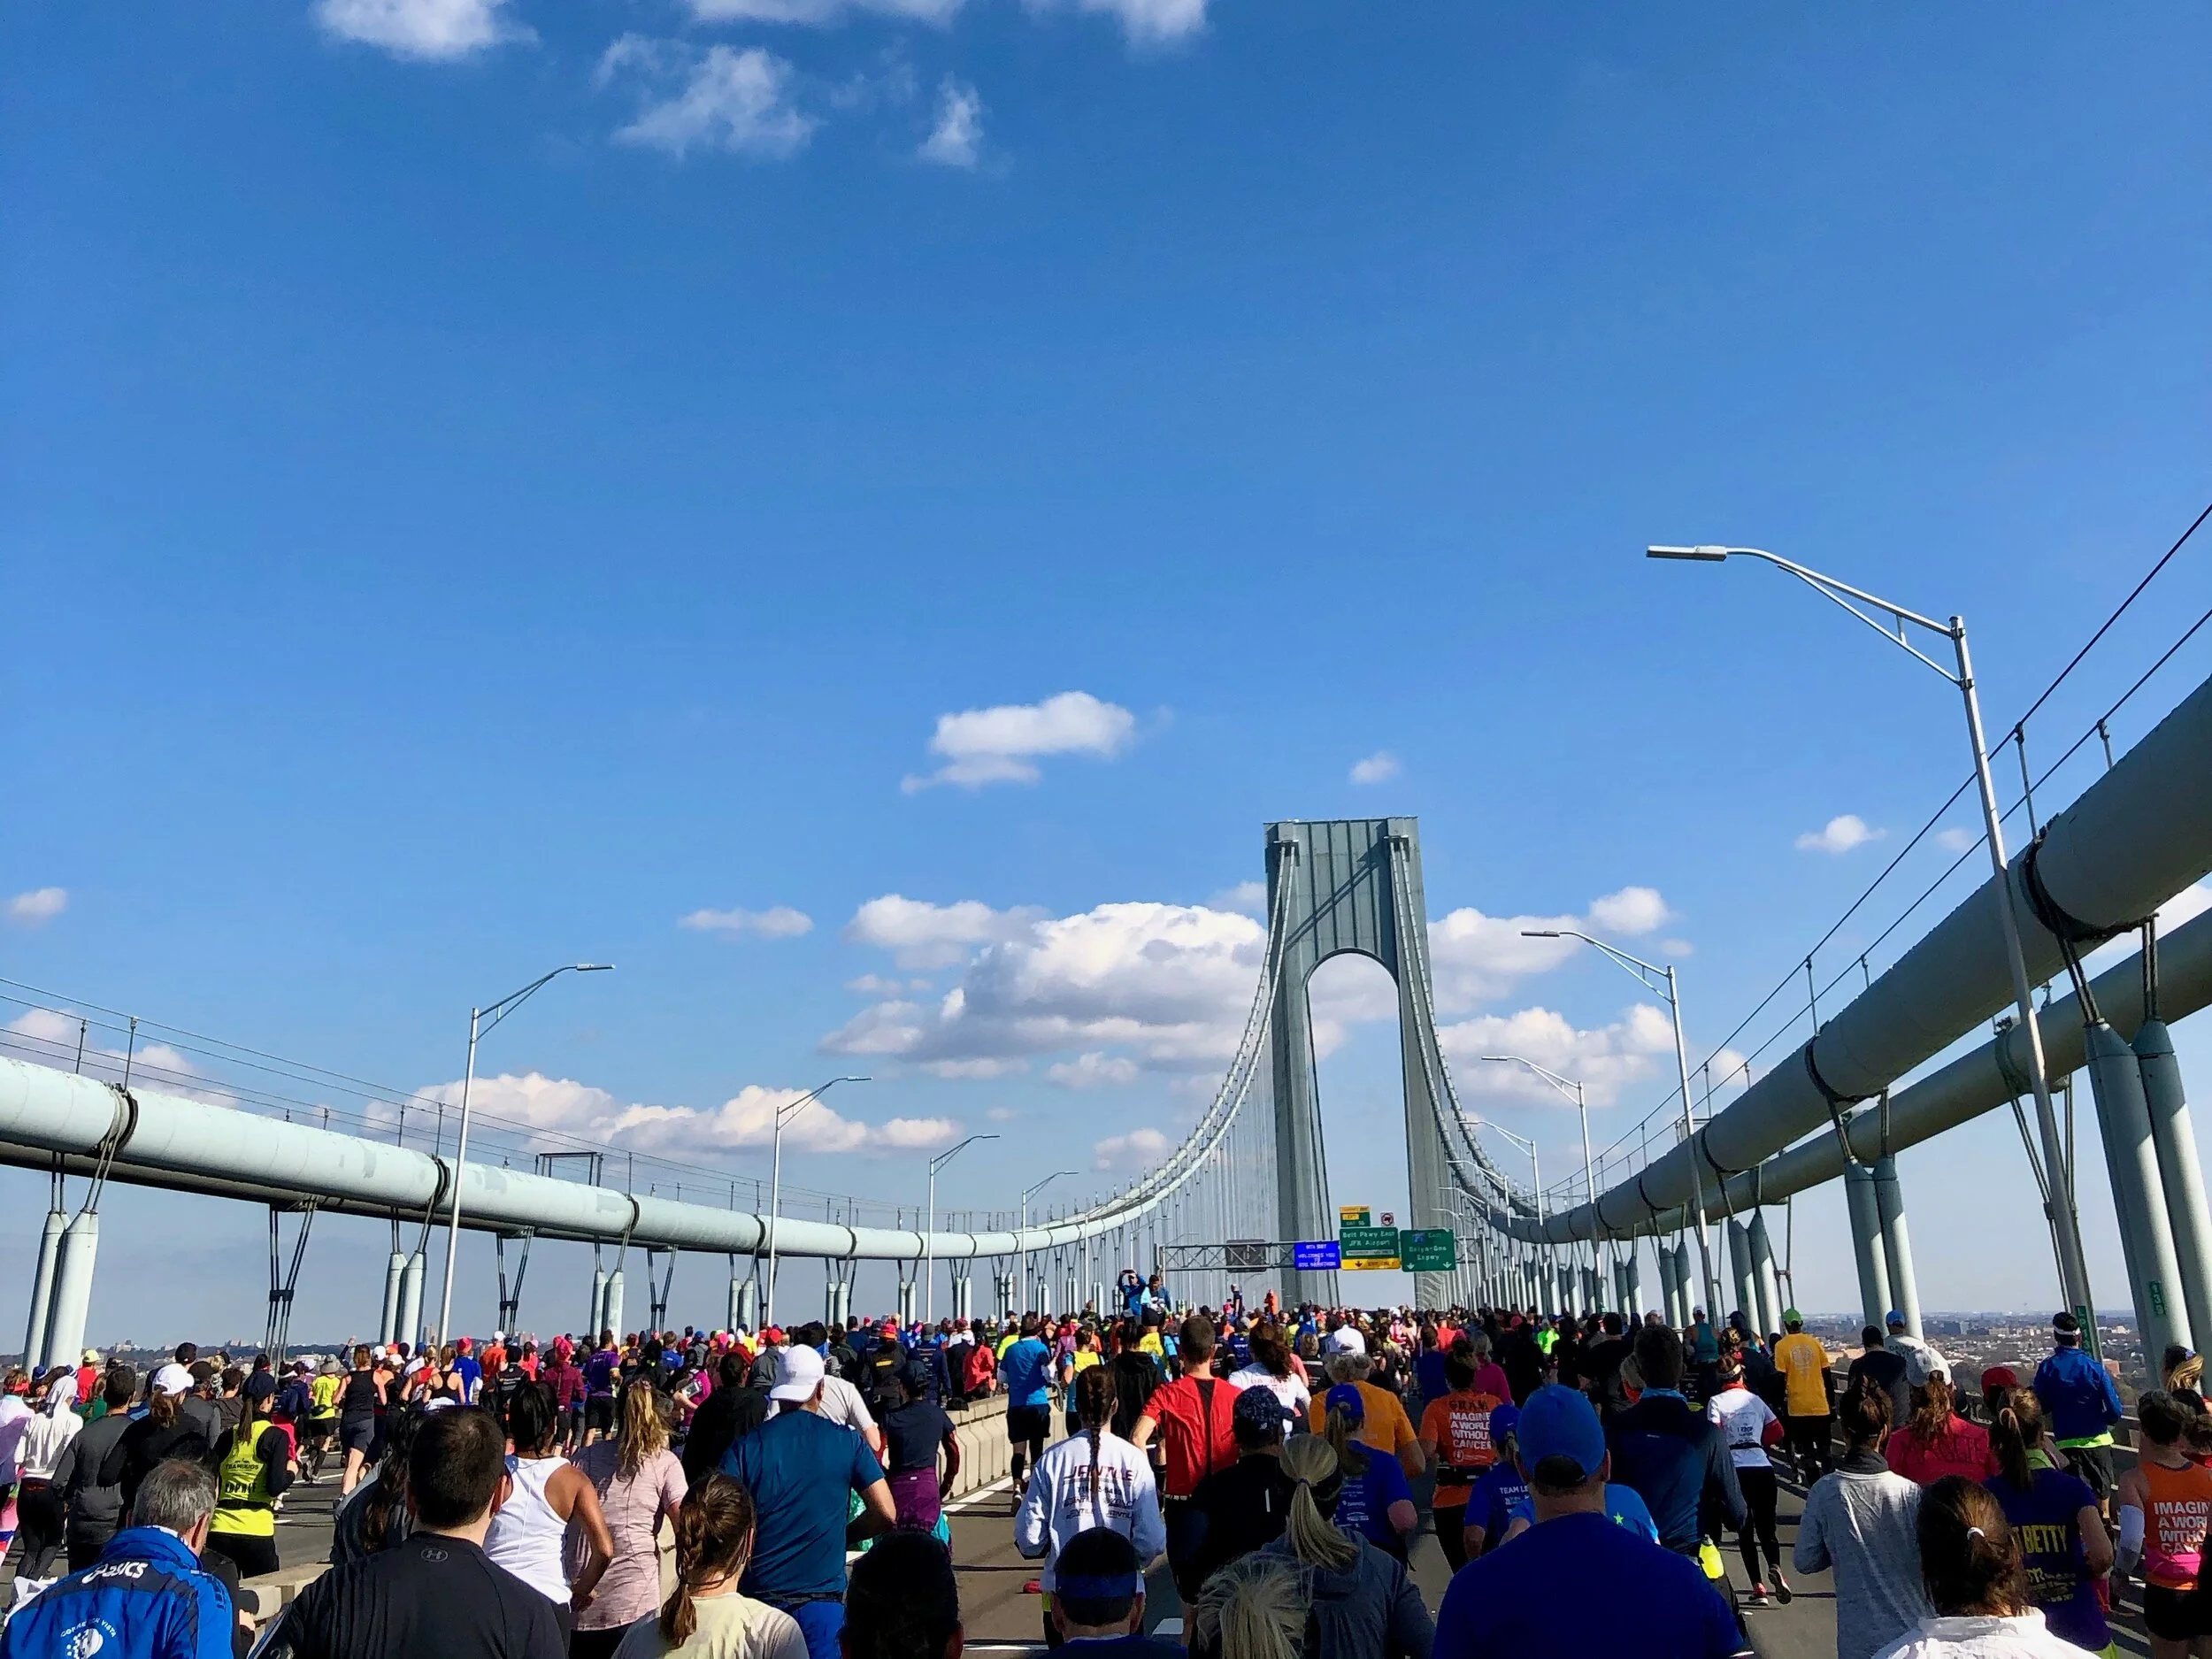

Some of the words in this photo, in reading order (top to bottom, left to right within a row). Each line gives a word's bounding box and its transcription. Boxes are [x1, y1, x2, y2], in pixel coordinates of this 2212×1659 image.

[1499, 1486, 1520, 1494] TEAM
[2153, 1501, 2210, 1515] IMAGIN
[2159, 1516, 2170, 1528] A
[2171, 1516, 2208, 1529] WOR
[2022, 1525, 2067, 1553] BETTY
[2159, 1530, 2207, 1542] WITHO
